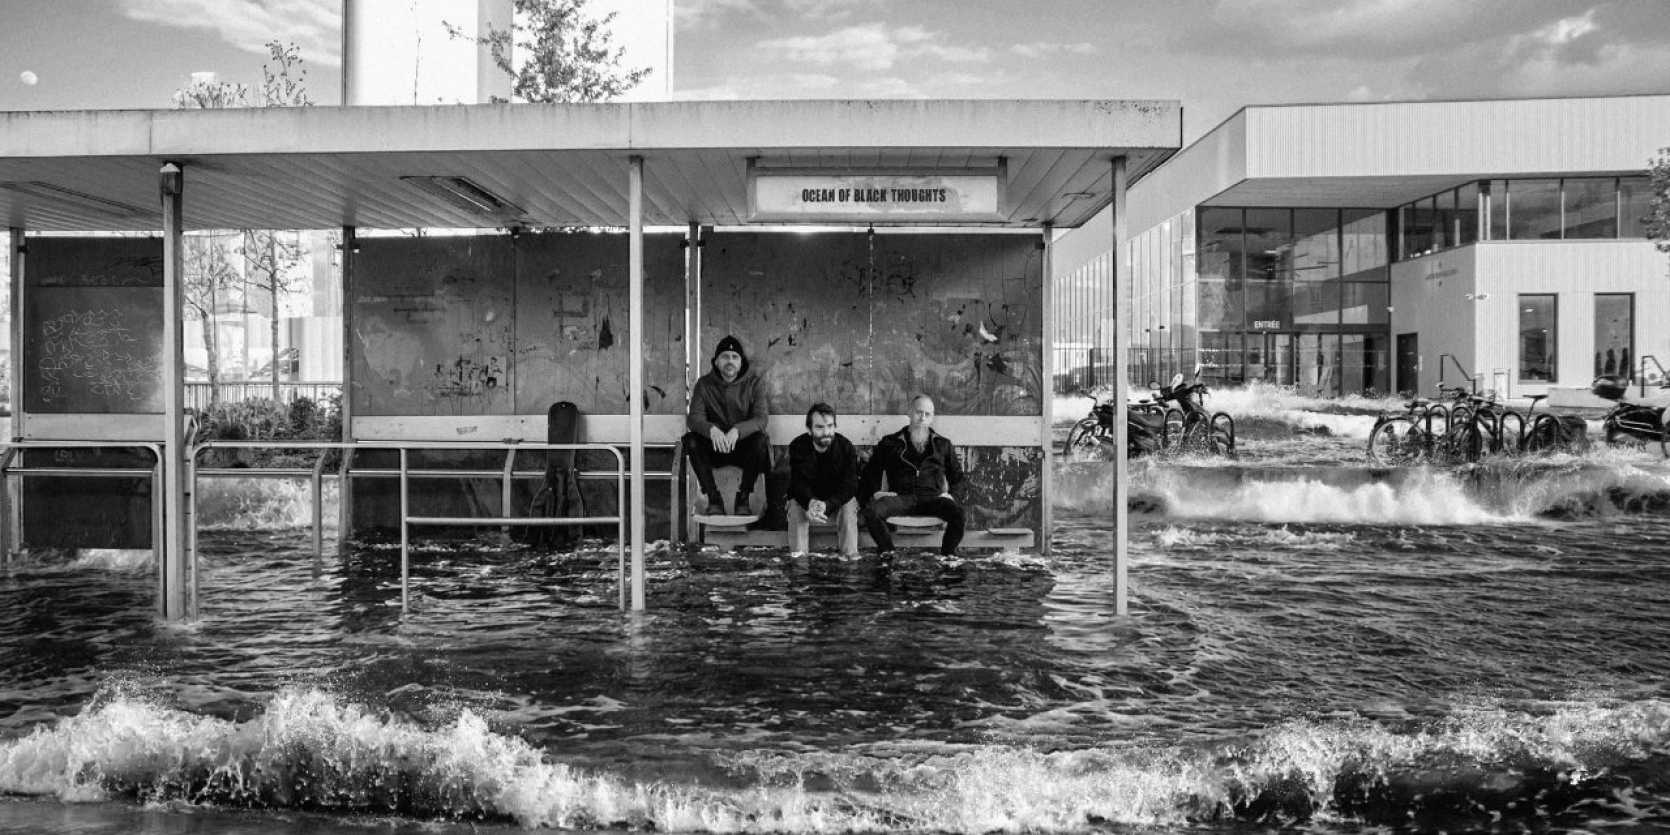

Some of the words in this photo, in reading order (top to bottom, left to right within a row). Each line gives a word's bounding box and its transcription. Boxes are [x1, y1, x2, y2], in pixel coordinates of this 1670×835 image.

[802, 188, 835, 202] OCEAN
[838, 188, 851, 202] OF
[854, 188, 887, 202] BLACK
[891, 188, 946, 202] THOUGHTS
[1254, 319, 1281, 329] ENTRÉE
